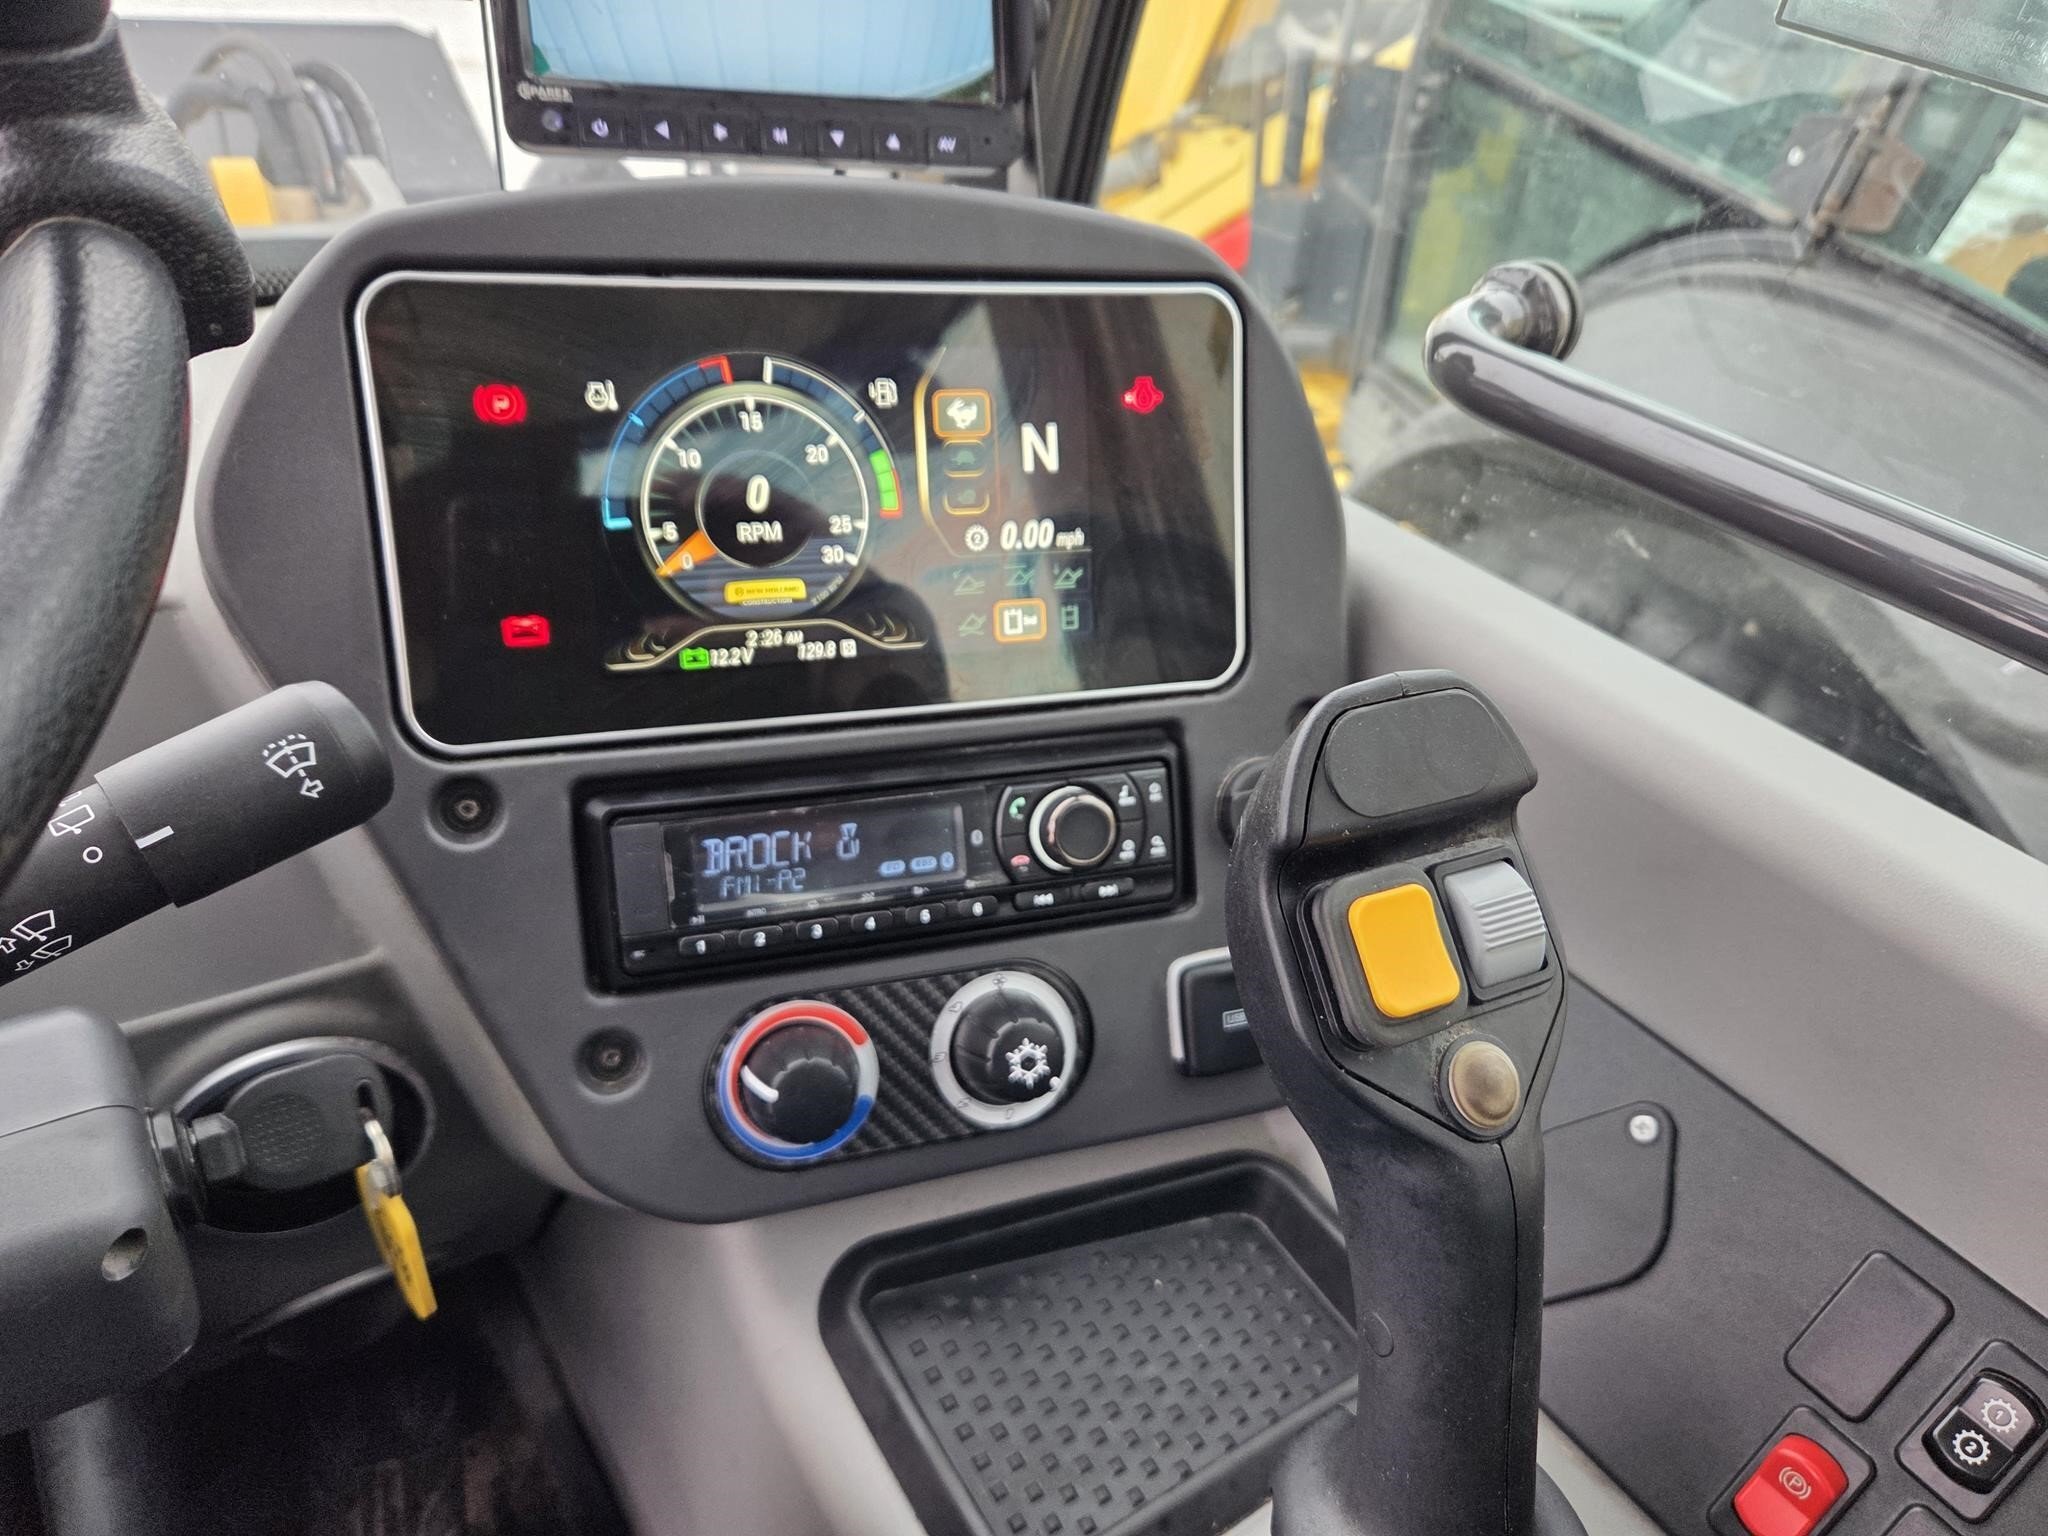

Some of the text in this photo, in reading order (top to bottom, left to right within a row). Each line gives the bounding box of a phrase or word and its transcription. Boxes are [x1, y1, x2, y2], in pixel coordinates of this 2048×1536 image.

[739, 411, 764, 432] 15
[805, 444, 829, 465] 20
[1021, 422, 1060, 474] N
[678, 448, 702, 469] 10
[746, 474, 770, 513] 0
[662, 521, 679, 542] 5
[736, 521, 783, 545] RPM
[829, 515, 852, 535] 25
[1000, 517, 1055, 550] 0.00
[1056, 527, 1085, 551] mph
[681, 552, 694, 571] 0
[820, 545, 844, 564] 30
[745, 628, 804, 648] 2:26 AM
[811, 924, 823, 939] 3
[865, 916, 876, 931] 4
[696, 940, 706, 954] 1
[754, 932, 767, 947] 2
[1994, 1409, 2004, 1420] 1
[1964, 1441, 1978, 1453] 2
[1788, 1475, 1803, 1489] P
